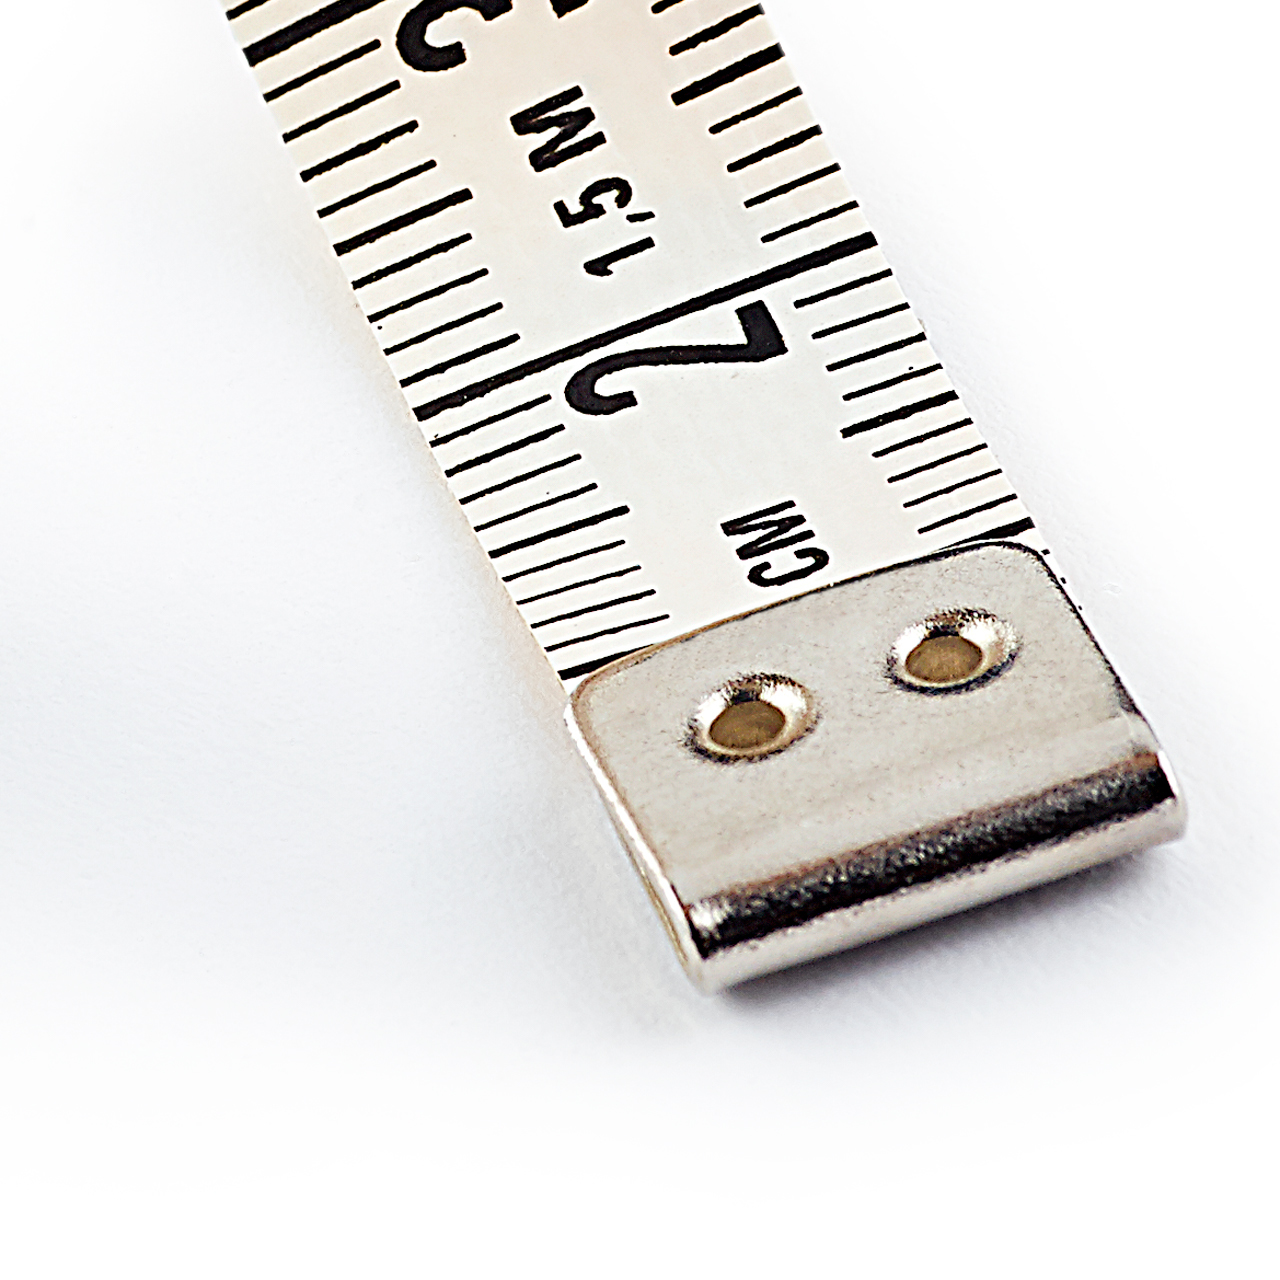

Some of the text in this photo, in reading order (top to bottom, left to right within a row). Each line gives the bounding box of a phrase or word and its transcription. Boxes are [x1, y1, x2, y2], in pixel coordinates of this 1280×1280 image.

[509, 85, 656, 277] 1,5 M
[564, 299, 789, 417] 2
[720, 500, 830, 588] CM
